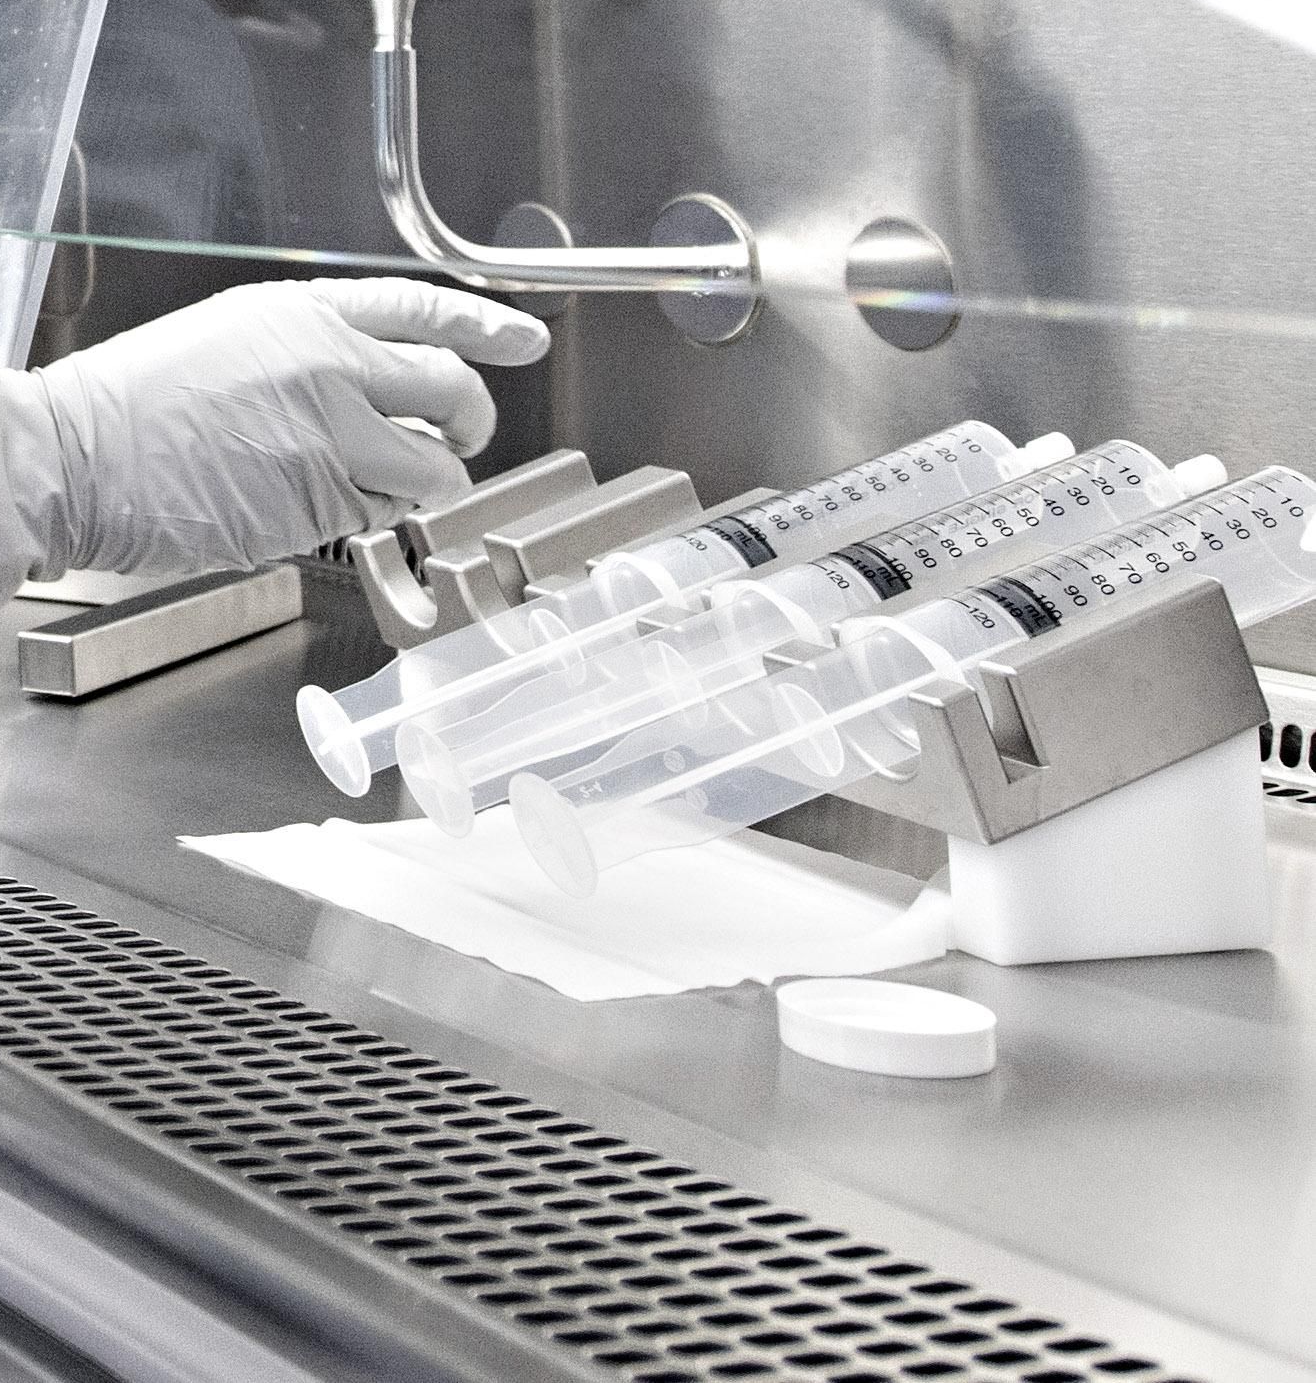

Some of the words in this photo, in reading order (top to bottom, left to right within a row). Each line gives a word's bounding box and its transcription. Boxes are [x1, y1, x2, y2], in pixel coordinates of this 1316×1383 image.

[936, 447, 957, 463] 20
[962, 438, 982, 453] 10
[890, 467, 910, 482] 40
[913, 457, 934, 473] 30
[1119, 465, 1140, 485] 10
[841, 486, 862, 501] 60
[865, 476, 886, 492] 50
[1092, 477, 1115, 496] 20
[818, 495, 838, 511] 70
[1068, 487, 1090, 506] 30
[793, 505, 814, 521] 80
[1043, 499, 1065, 517] 40
[1280, 497, 1304, 517] 10
[768, 515, 790, 531] 90
[1017, 508, 1040, 527] 50
[1252, 507, 1277, 529] 20
[966, 527, 988, 548] 70
[992, 519, 1014, 537] 60
[1226, 519, 1250, 540] 30
[734, 530, 753, 548] mL
[940, 538, 962, 558] 80
[1200, 530, 1224, 551] 40
[914, 549, 937, 569] 90
[1172, 541, 1196, 562] 50
[888, 557, 913, 581] 100
[1146, 553, 1170, 573] 60
[826, 569, 850, 589] 120
[877, 567, 898, 587] mL
[1118, 563, 1142, 585] 70
[1091, 575, 1115, 596] 80
[1064, 585, 1088, 607] 90
[1024, 605, 1047, 627] mL
[1037, 594, 1062, 619] 100
[969, 607, 996, 629] 120
